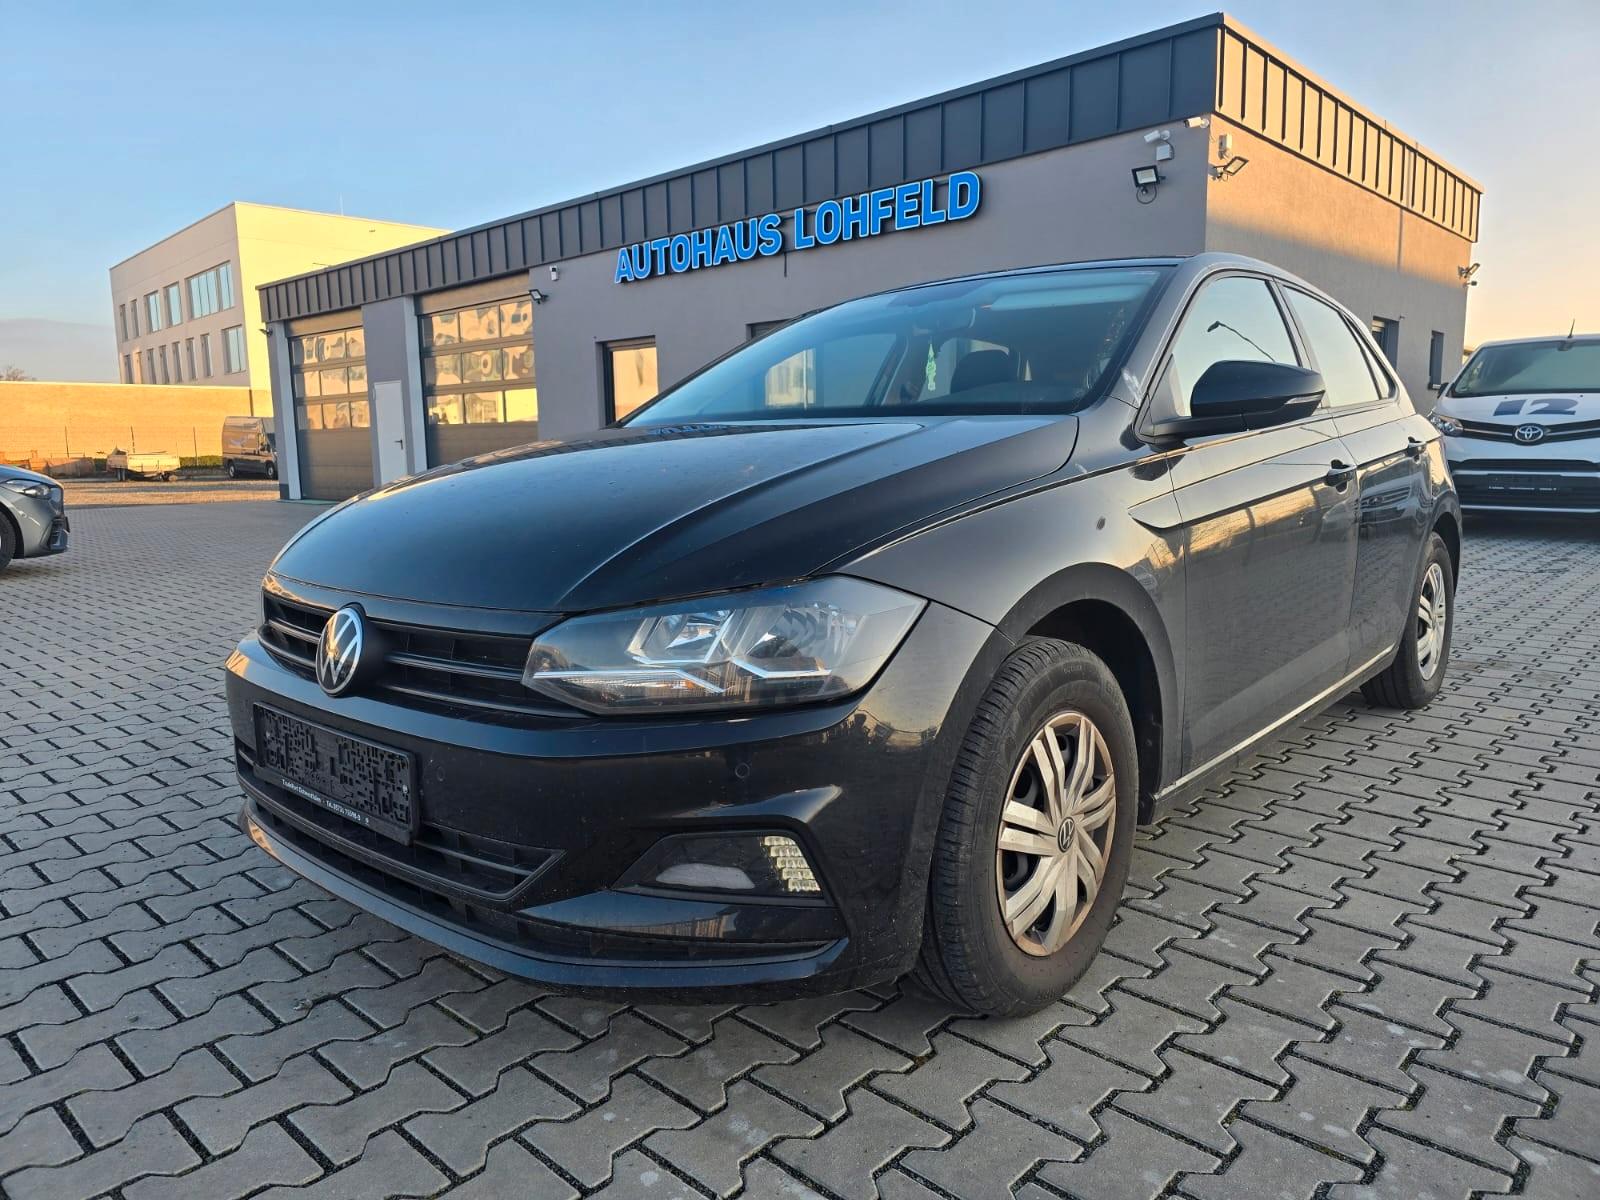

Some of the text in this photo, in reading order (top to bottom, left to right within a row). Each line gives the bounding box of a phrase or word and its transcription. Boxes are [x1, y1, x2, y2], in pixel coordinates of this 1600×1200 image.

[614, 171, 981, 284] AUTOHAUS LOHFELD
[317, 608, 362, 692] VW
